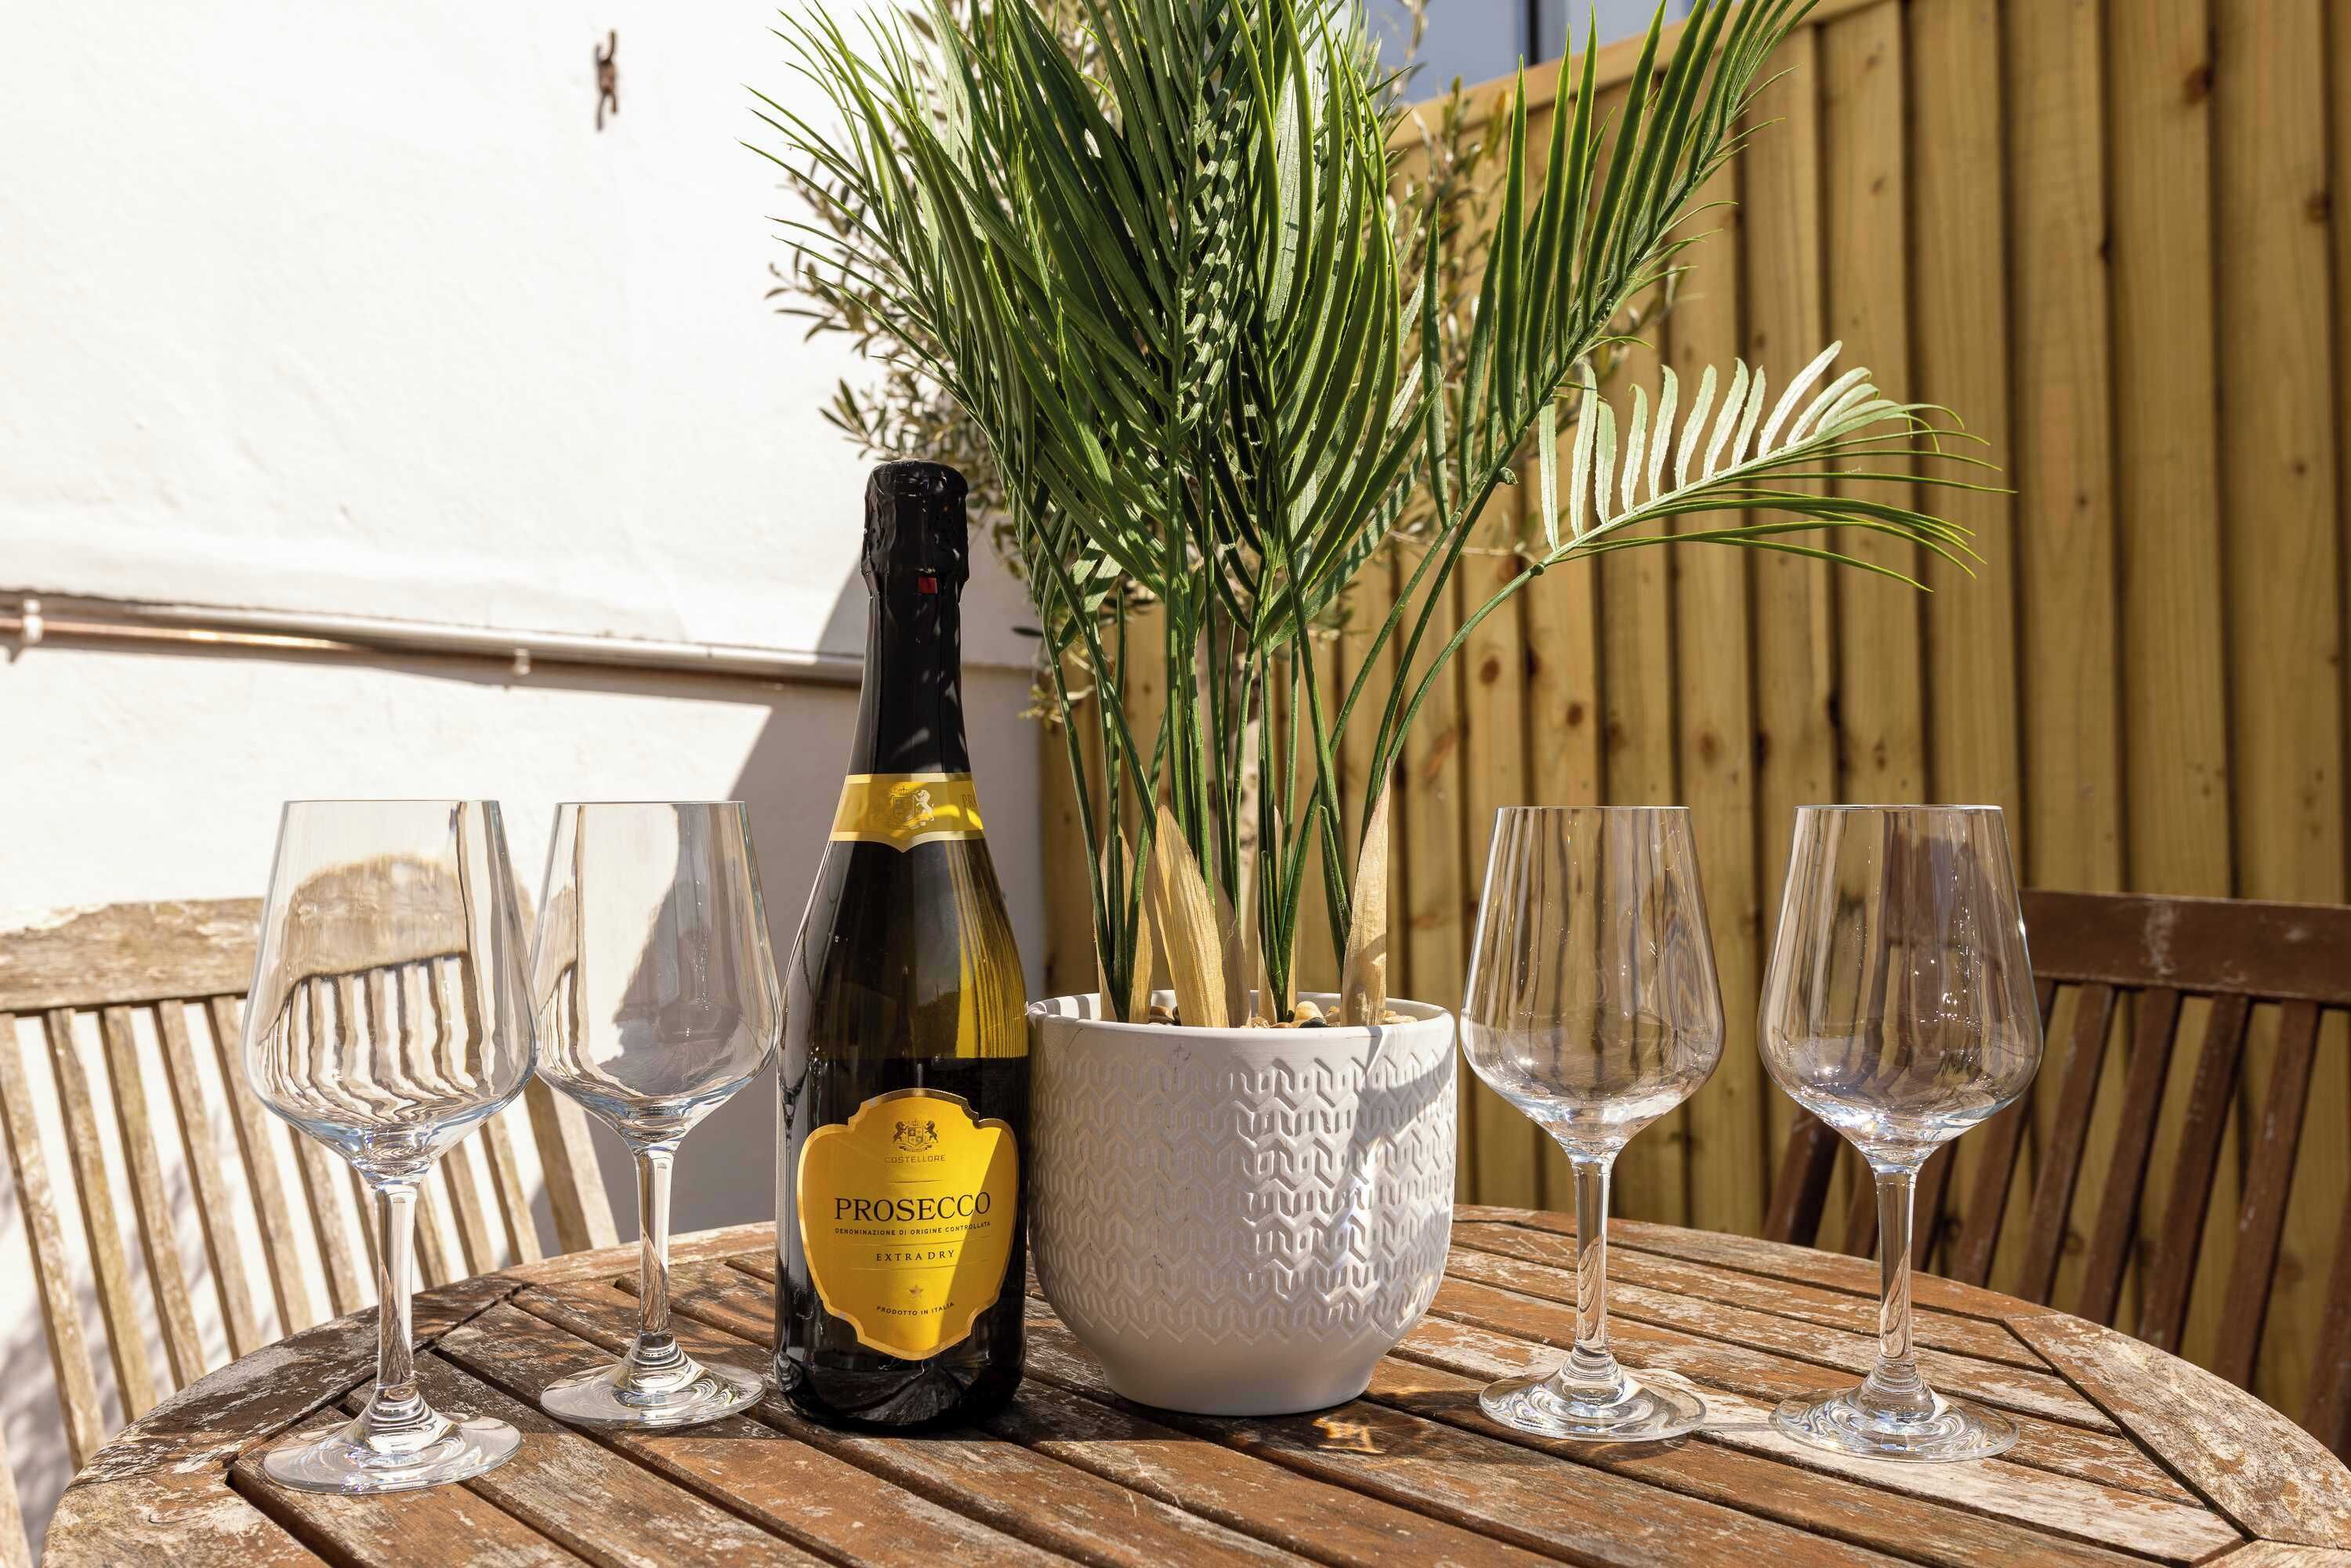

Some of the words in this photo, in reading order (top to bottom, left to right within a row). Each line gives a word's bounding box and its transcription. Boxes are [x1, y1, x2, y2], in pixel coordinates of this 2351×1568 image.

[835, 1192, 991, 1222] PROSECCO
[945, 1221, 991, 1233] CONTROLLATA
[876, 1253, 922, 1262] EXTRA
[928, 1250, 955, 1260] DRY
[876, 1305, 918, 1316] PRODOTTO
[931, 1302, 955, 1313] ITALIA
